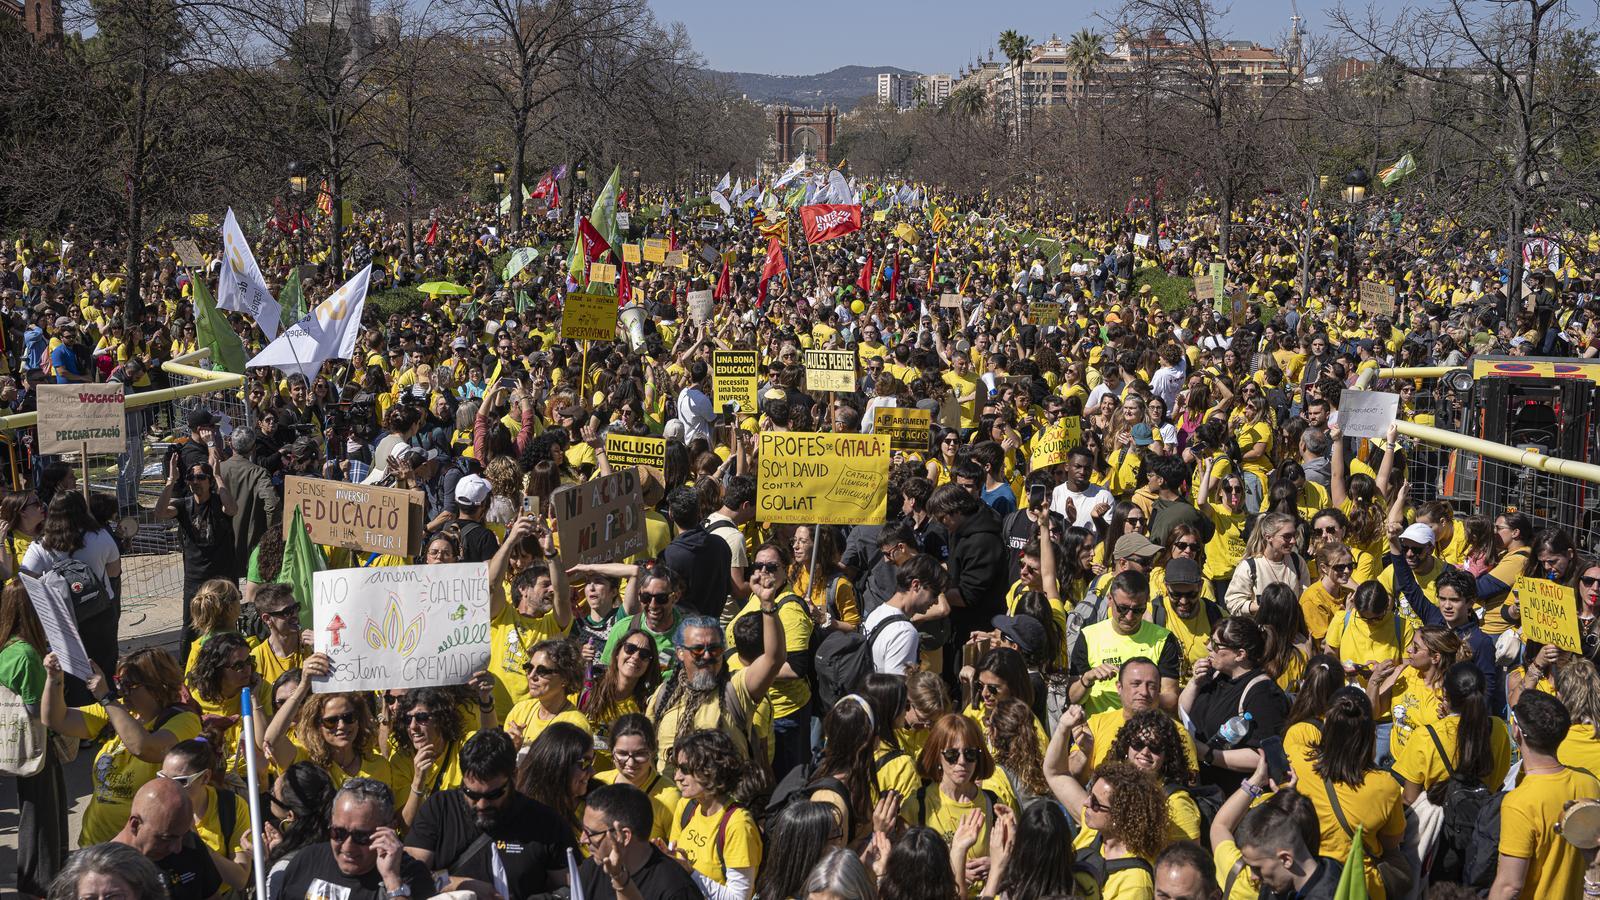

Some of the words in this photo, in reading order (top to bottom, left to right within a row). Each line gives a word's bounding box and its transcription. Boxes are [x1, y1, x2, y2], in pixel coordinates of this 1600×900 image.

[716, 363, 755, 373] EDUCACIÓ
[807, 353, 828, 369] AULES
[829, 354, 854, 370] PLENES
[608, 440, 665, 456] INCLUSIÓ
[761, 435, 826, 457] PROFES
[835, 437, 886, 458] CATALÀ:
[626, 456, 655, 464] RECURSOS
[656, 457, 663, 465] ÉS
[761, 459, 788, 478] SOM
[793, 462, 829, 478] DAVID
[296, 481, 326, 498] SENSE
[336, 489, 370, 503] INVERSIÓ
[382, 496, 396, 508] EN
[592, 471, 634, 508] ACORD
[762, 481, 804, 490] CONTRA
[302, 498, 400, 530] EDUCACIÓ
[365, 530, 394, 549] FUTUR
[320, 576, 348, 606] NO
[365, 570, 422, 584] anem
[429, 577, 489, 606] CALENTES
[1528, 580, 1537, 594] LA
[1530, 597, 1540, 611] NO
[1523, 606, 1533, 620] EL
[1537, 611, 1559, 630] CAOS
[1531, 625, 1542, 640] NO
[1544, 629, 1577, 649] MARXA
[402, 651, 489, 682] CREMADES
[1102, 656, 1122, 665] CURSA
[686, 828, 708, 848] SOS
